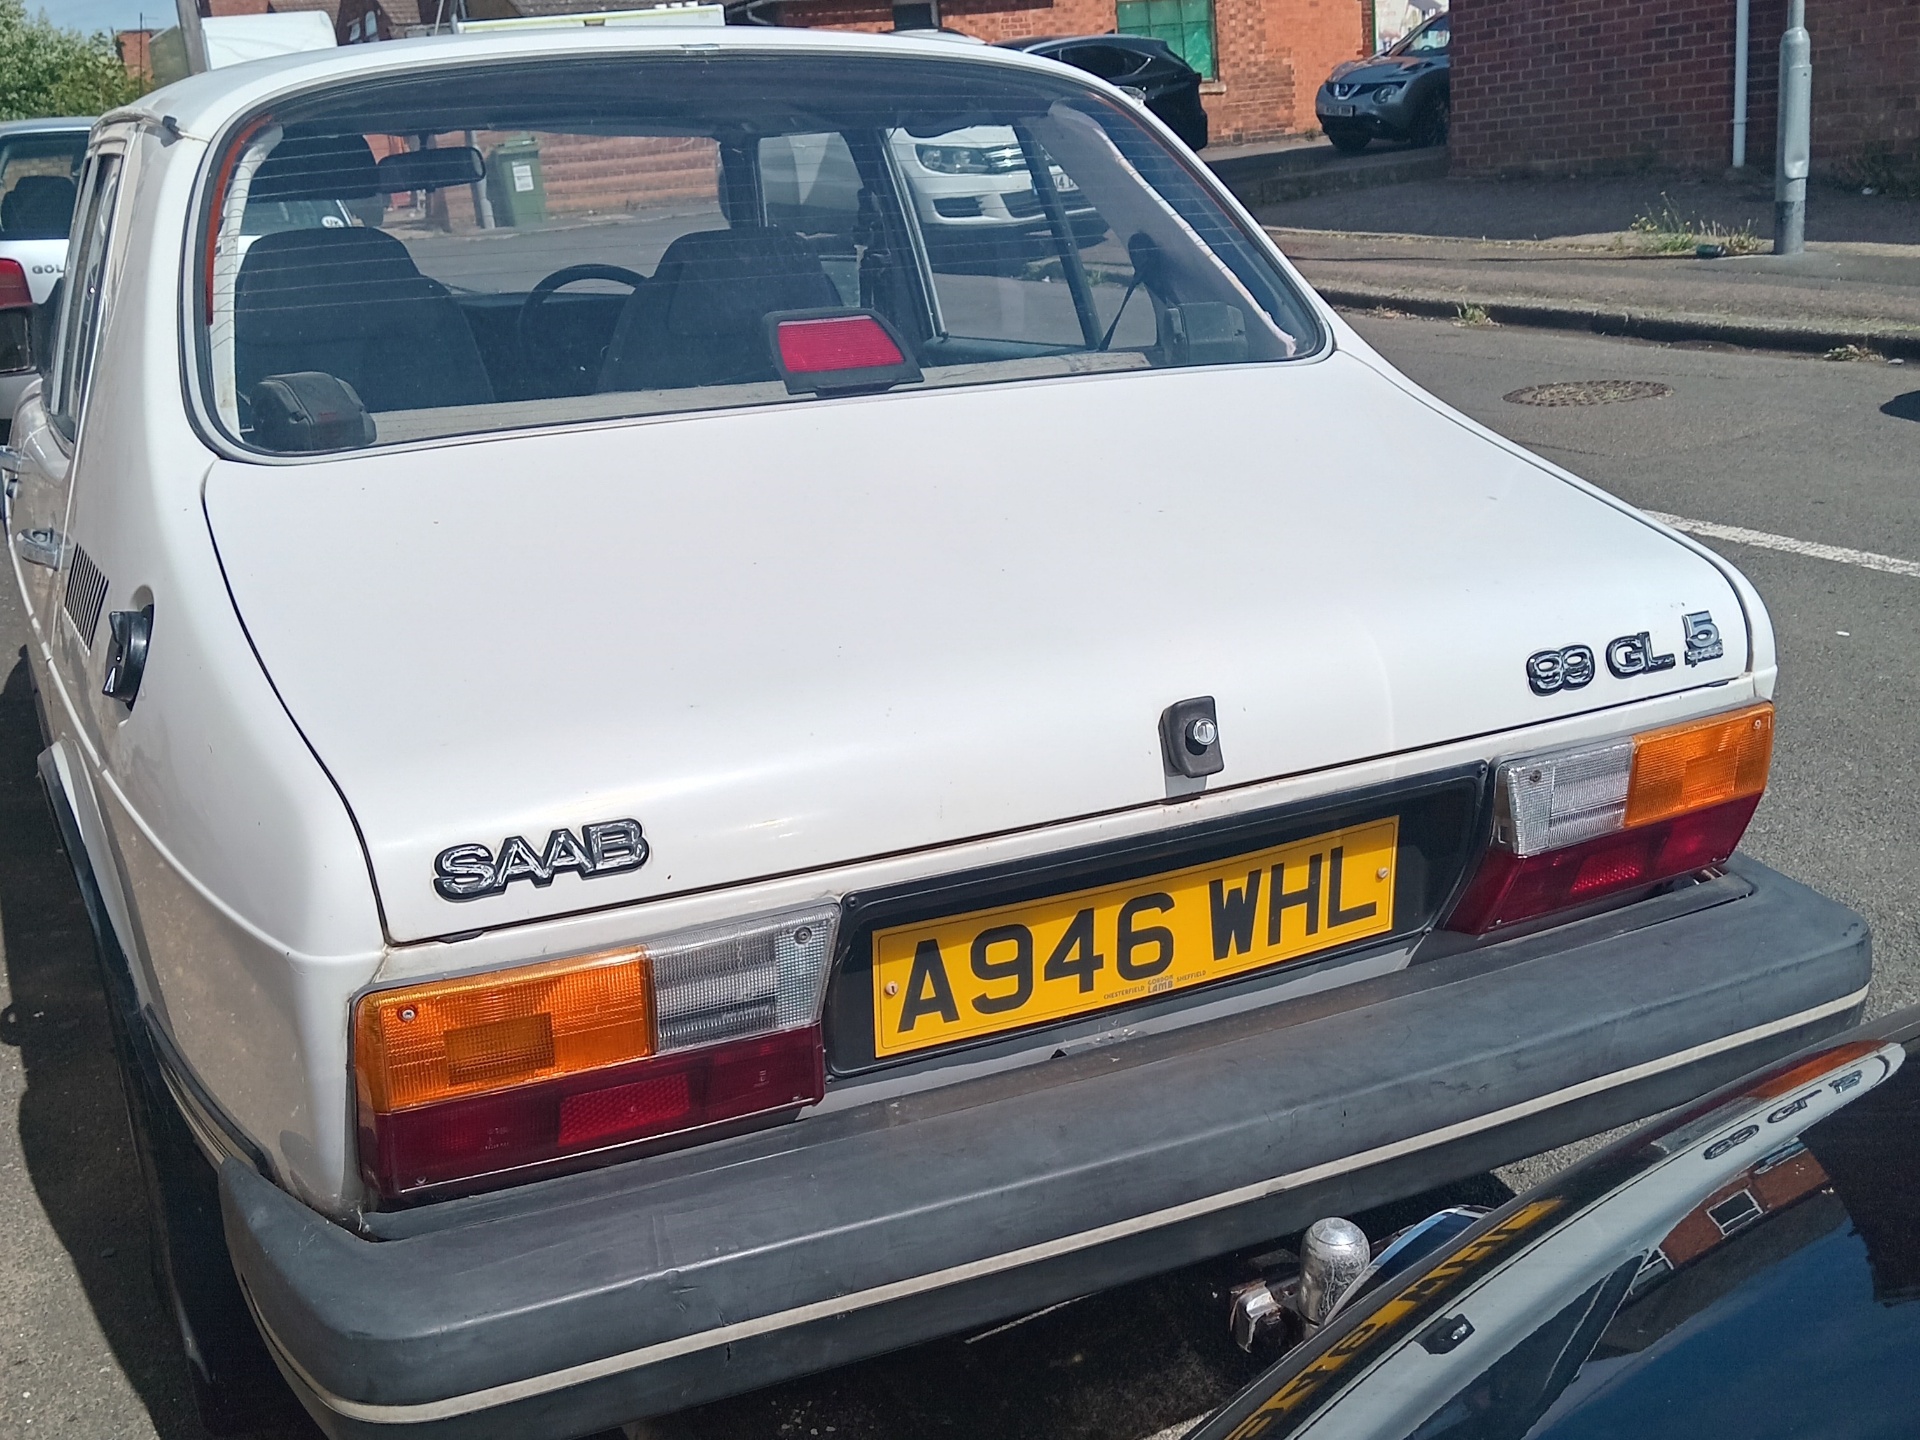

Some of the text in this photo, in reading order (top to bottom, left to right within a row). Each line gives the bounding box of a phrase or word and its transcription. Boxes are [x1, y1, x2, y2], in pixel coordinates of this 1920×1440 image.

[31, 264, 65, 274] GOL
[1526, 610, 1720, 697] 99 GL 5
[433, 818, 650, 903] SAAB
[897, 845, 1378, 1034] A946 WHL
[1176, 970, 1207, 983] SHEFFIELD
[1103, 985, 1145, 1000] CHESTERFIELD
[1147, 980, 1174, 994] LAMB
